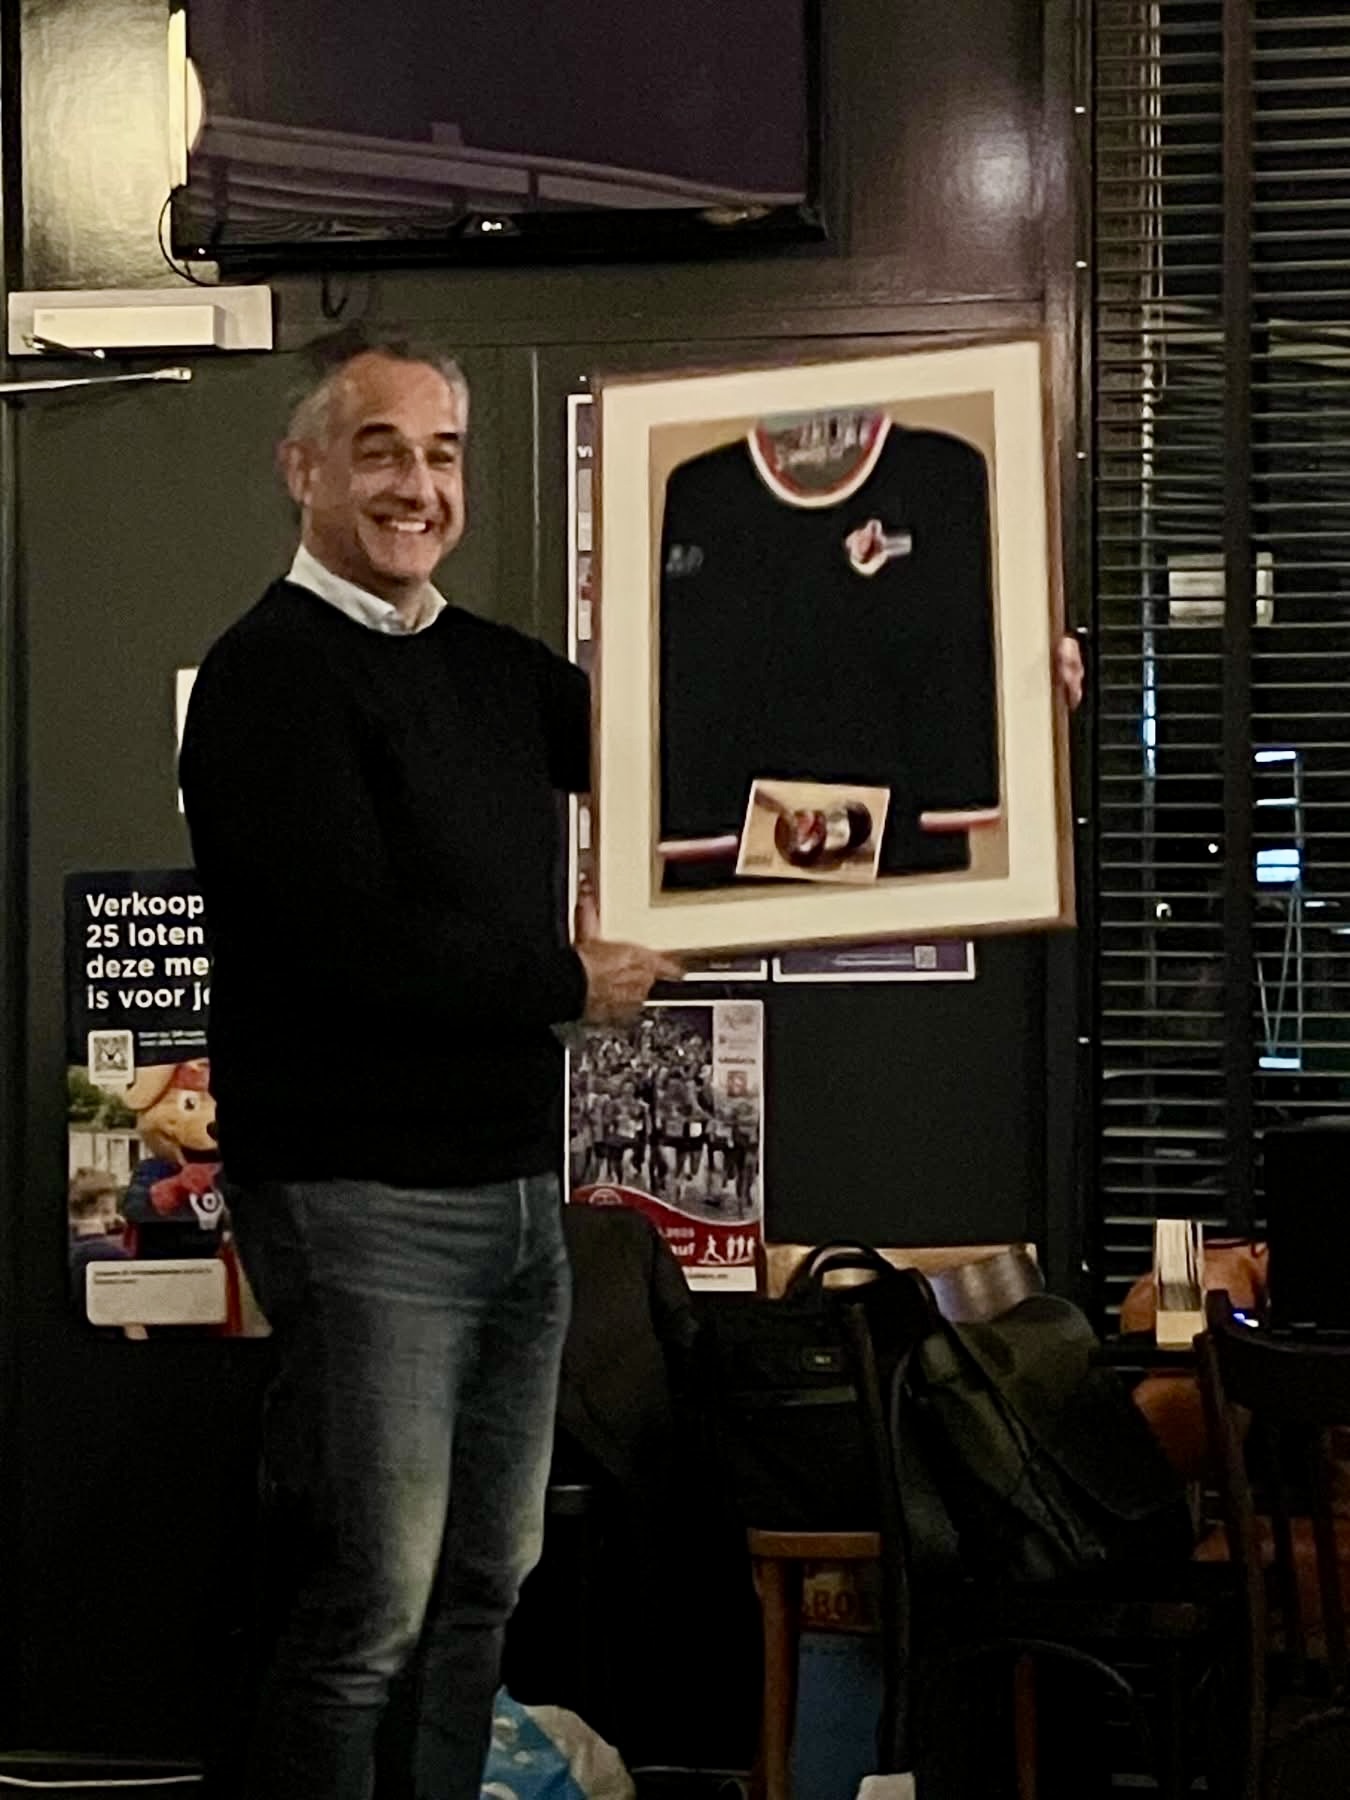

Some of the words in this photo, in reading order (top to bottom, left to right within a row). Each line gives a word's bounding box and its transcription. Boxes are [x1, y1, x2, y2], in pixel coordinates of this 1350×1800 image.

[86, 891, 204, 919] Verkoop
[86, 924, 119, 948] 25
[129, 922, 204, 947] loten
[86, 953, 155, 978] deze
[164, 956, 211, 976] me
[87, 984, 110, 1009] is
[118, 988, 186, 1008] voor
